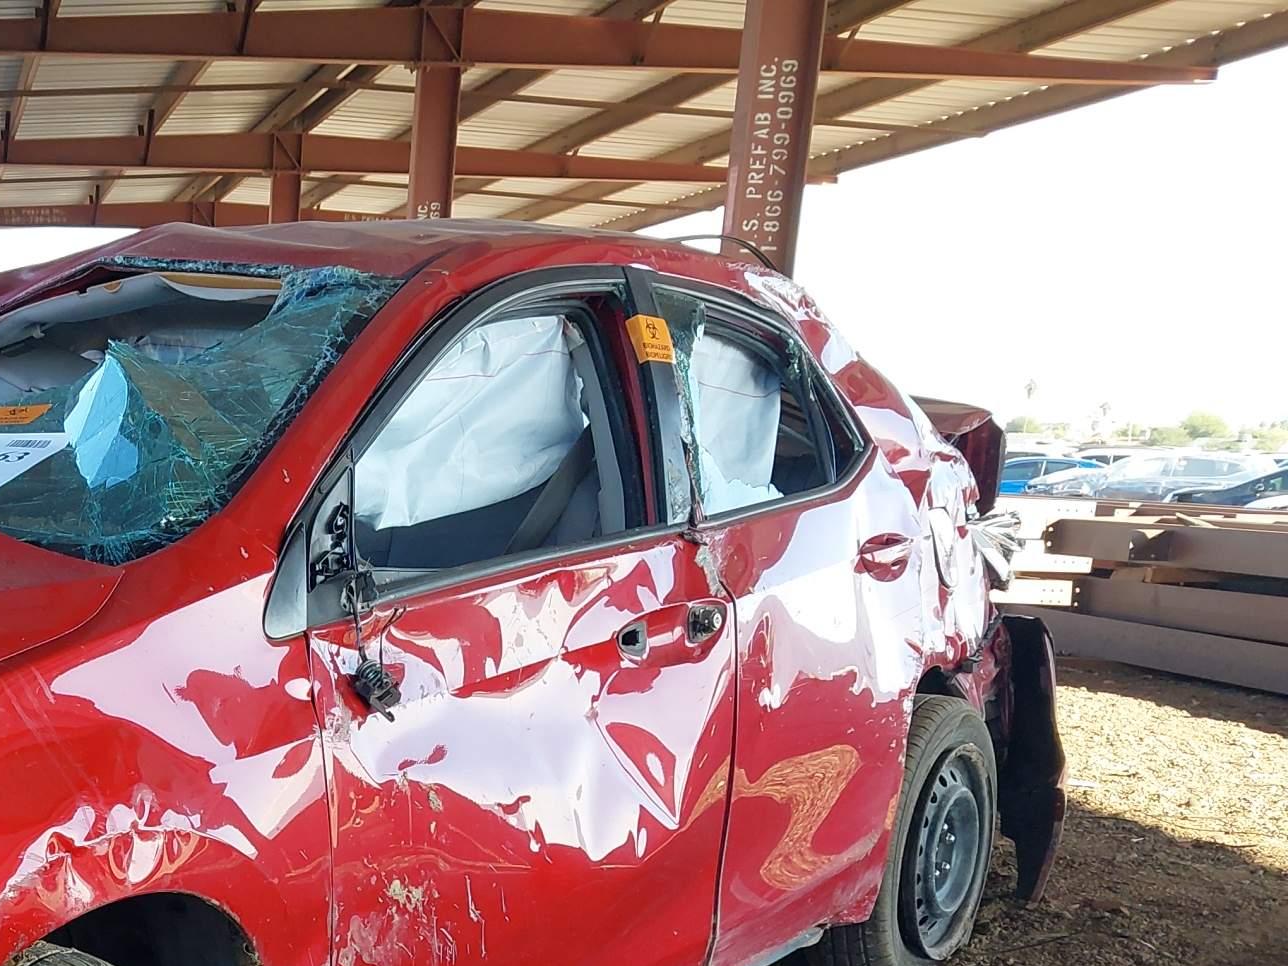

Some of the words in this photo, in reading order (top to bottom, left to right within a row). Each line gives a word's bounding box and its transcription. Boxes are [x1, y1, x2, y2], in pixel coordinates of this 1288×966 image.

[757, 57, 779, 99] INC.
[745, 112, 772, 199] PREFAB
[760, 59, 799, 251] 1-866-799-0969
